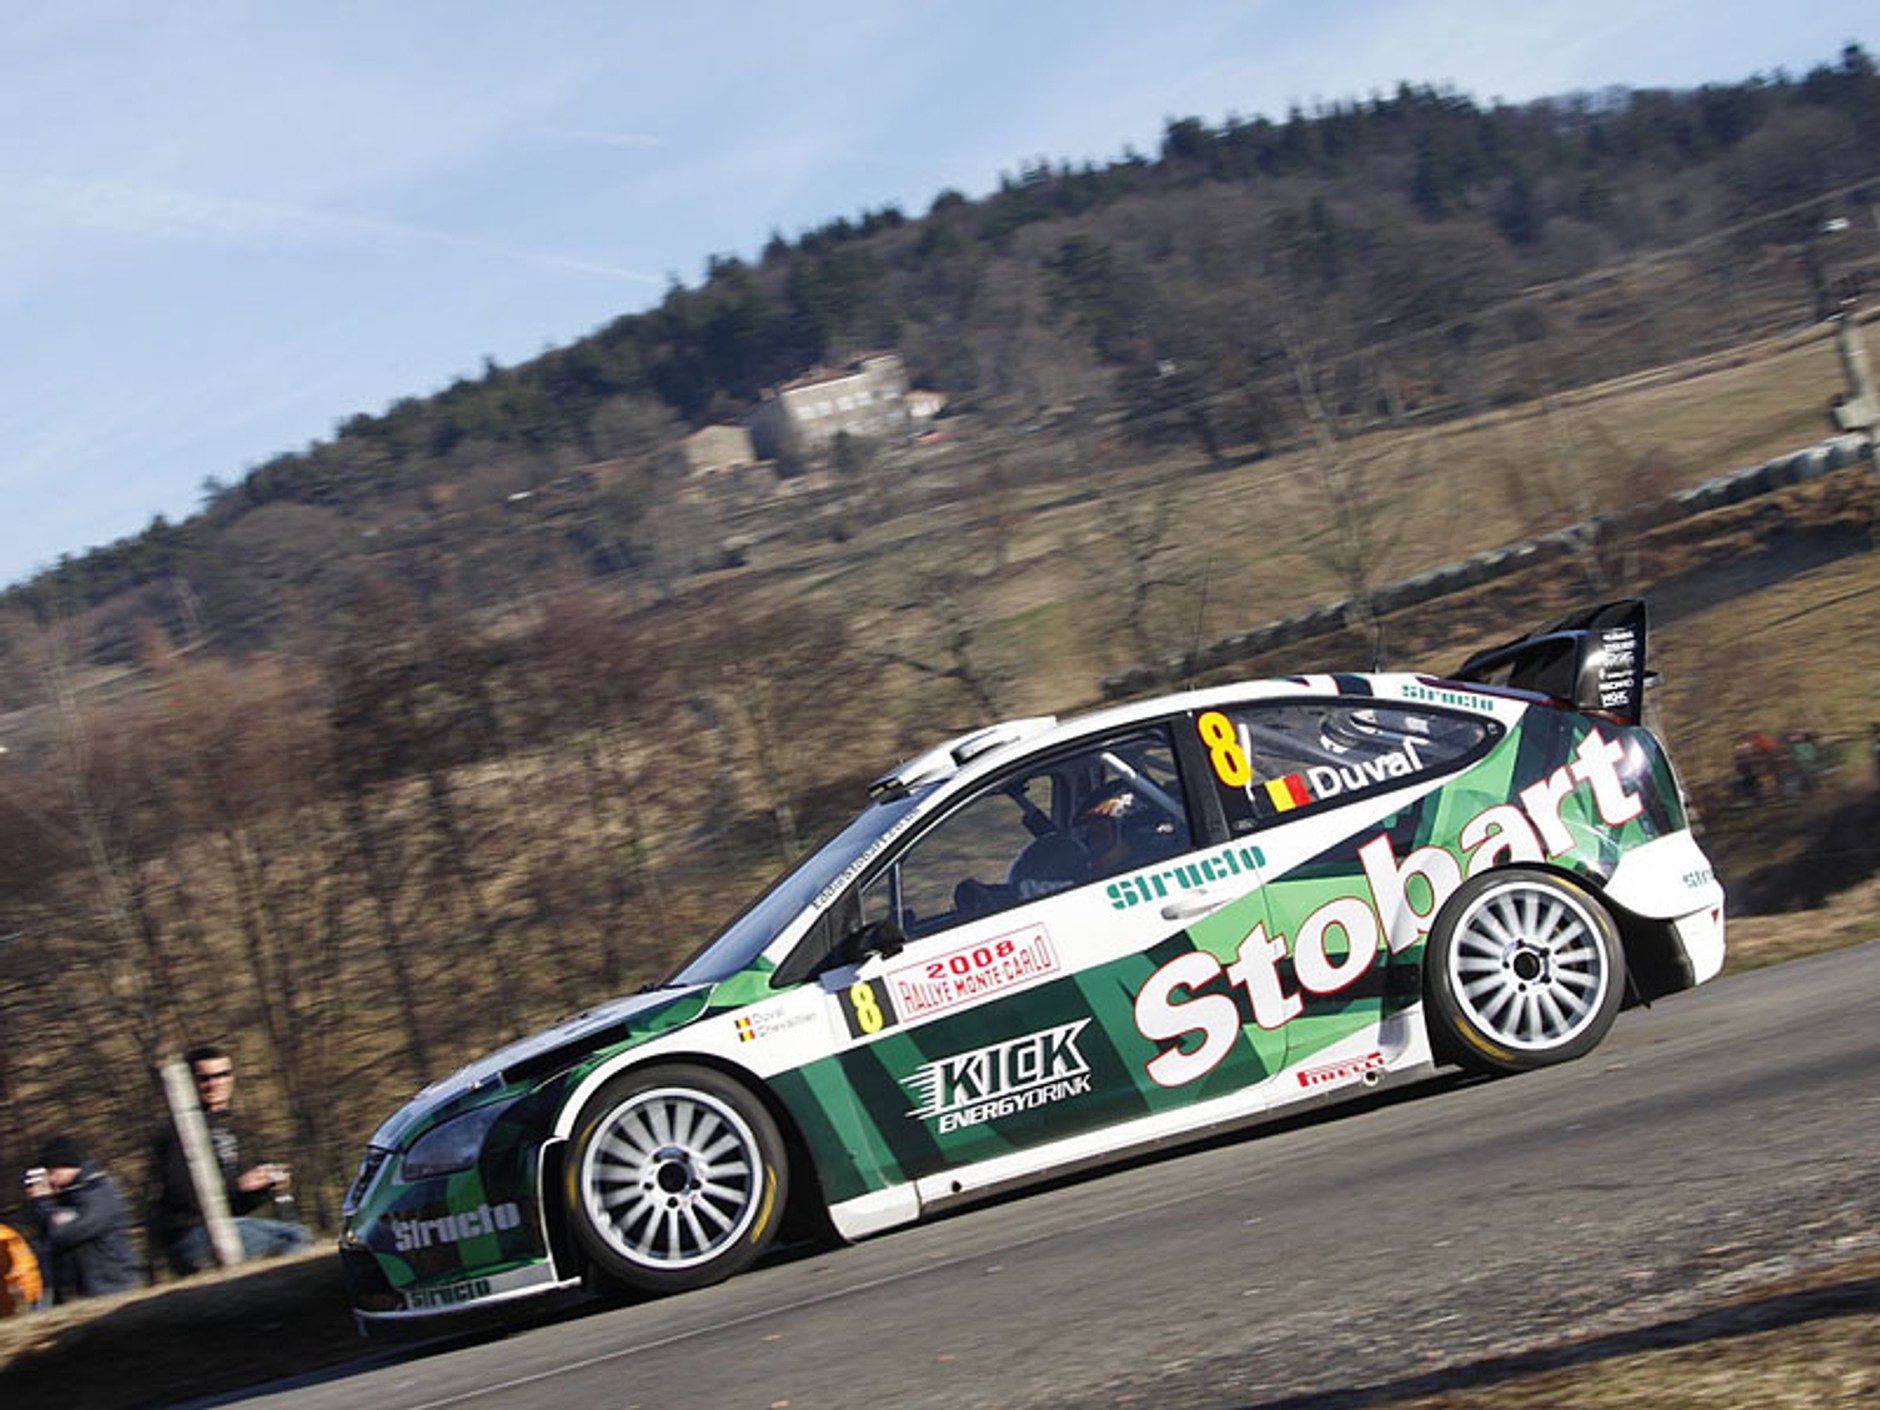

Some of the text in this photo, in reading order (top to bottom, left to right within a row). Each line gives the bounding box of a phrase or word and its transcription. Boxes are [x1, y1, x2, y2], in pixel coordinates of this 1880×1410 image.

[1198, 711, 1251, 787] 8
[1306, 738, 1425, 800] Duval
[1134, 726, 1645, 1088] Stobart
[926, 940, 1015, 979] 2008
[850, 980, 884, 1034] 8
[898, 981, 953, 1014] RALLYE
[932, 1020, 1091, 1112] KICK
